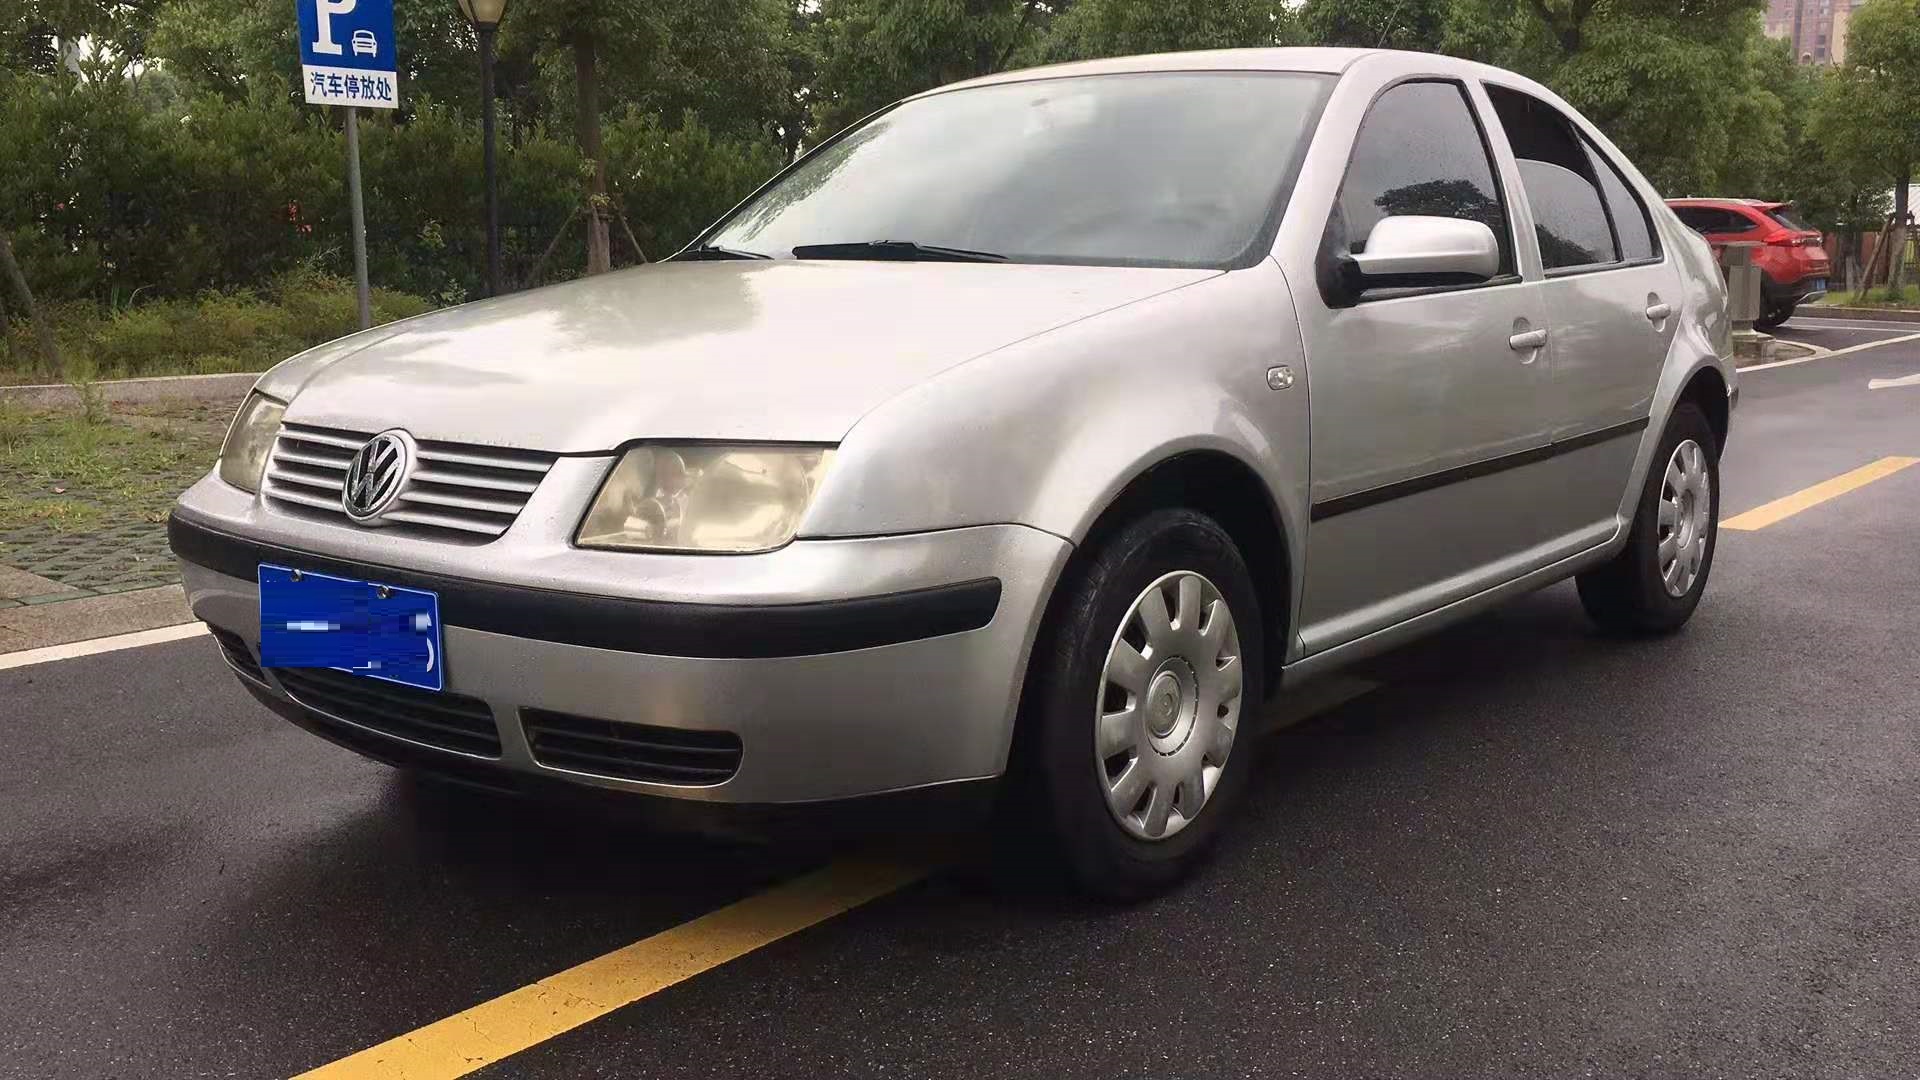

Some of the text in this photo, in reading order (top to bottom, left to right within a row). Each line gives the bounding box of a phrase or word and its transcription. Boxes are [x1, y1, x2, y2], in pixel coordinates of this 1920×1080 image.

[312, 0, 356, 55] P
[310, 72, 392, 101] 汽车停放处
